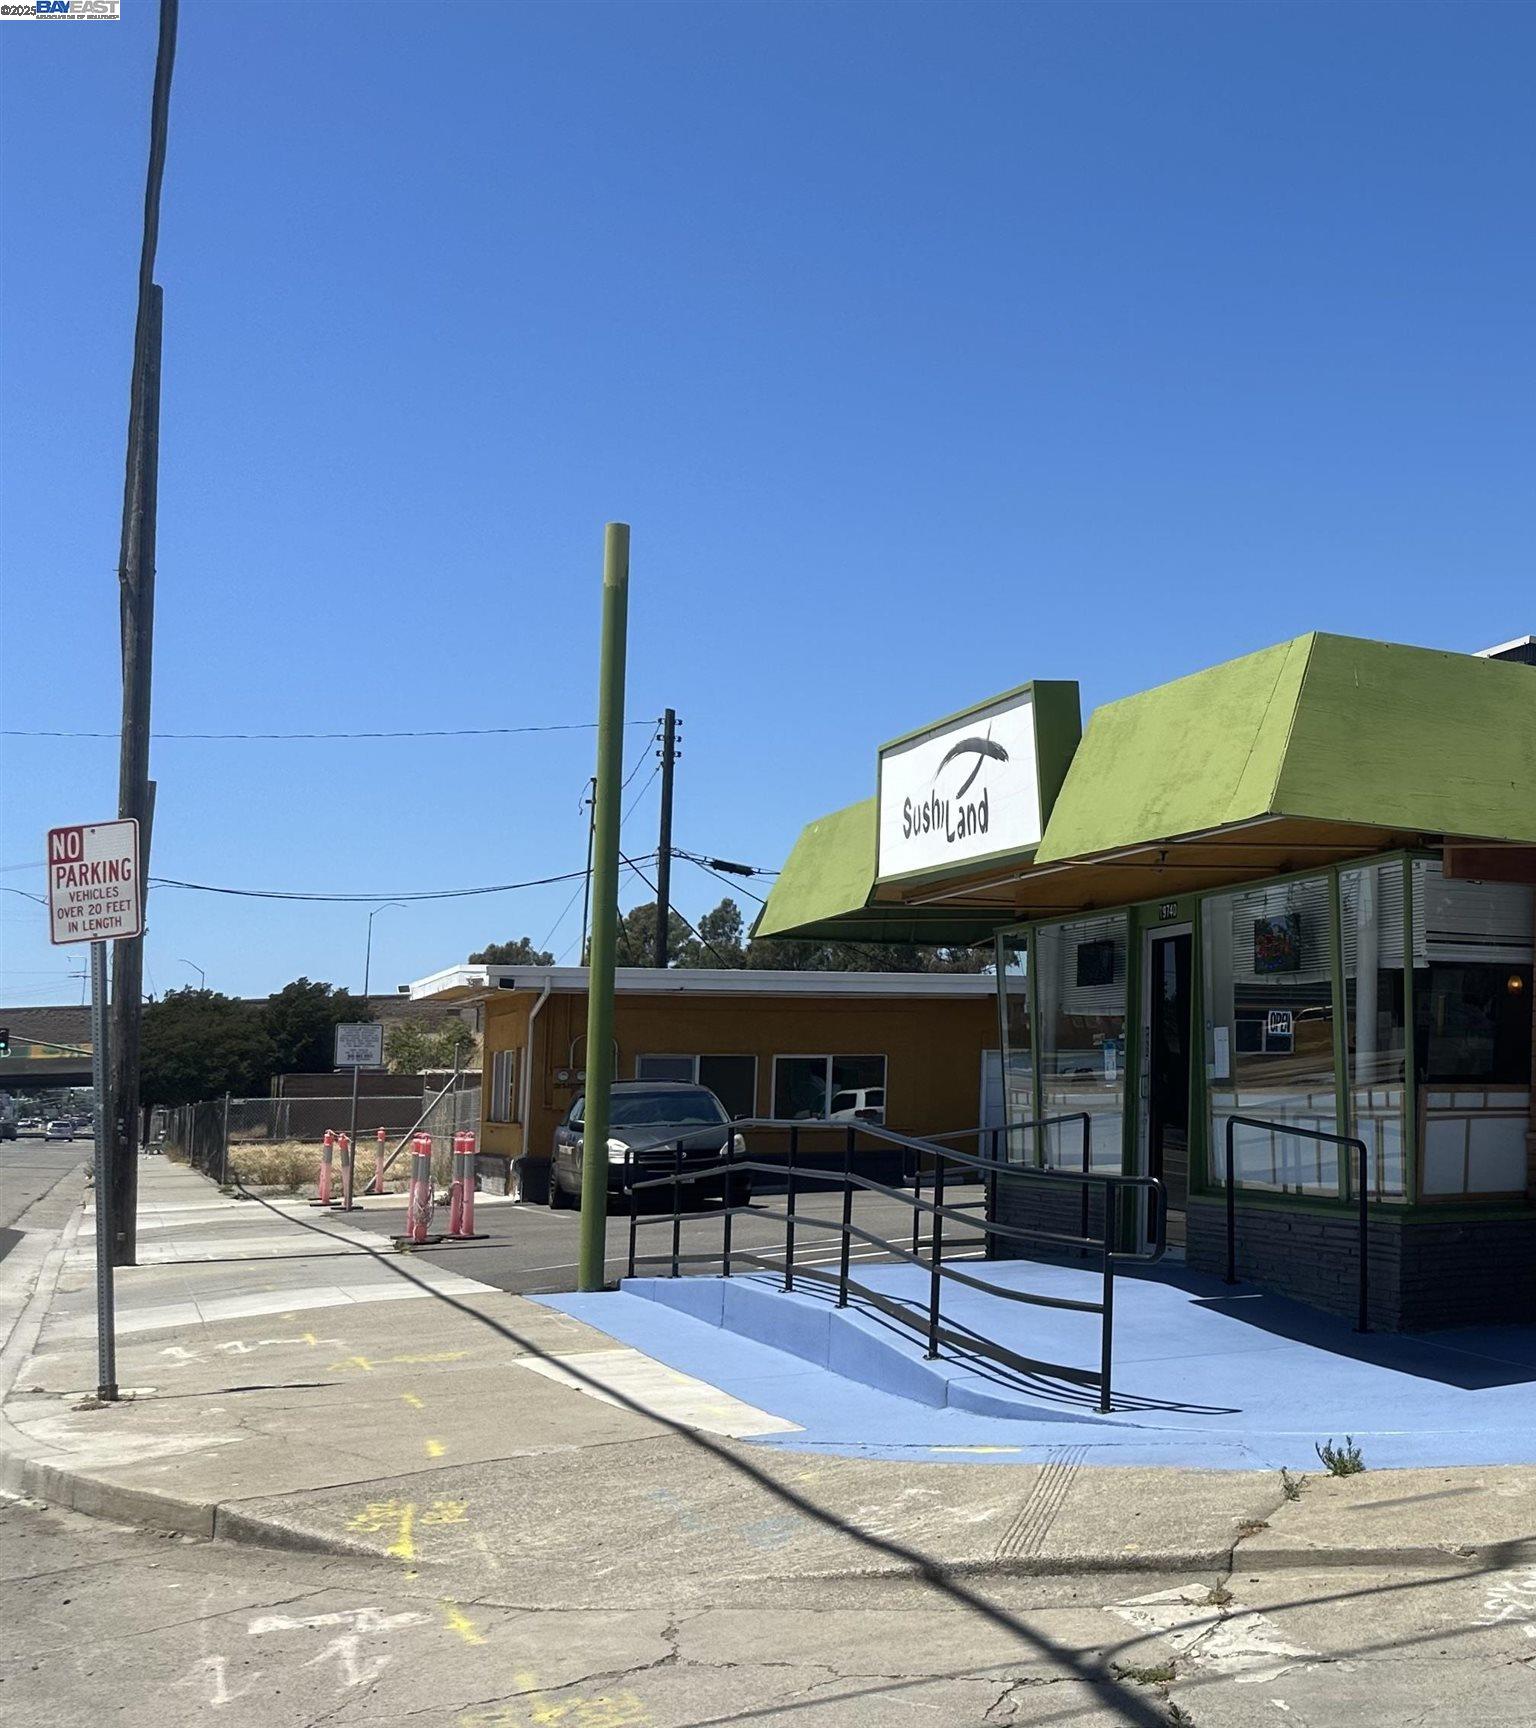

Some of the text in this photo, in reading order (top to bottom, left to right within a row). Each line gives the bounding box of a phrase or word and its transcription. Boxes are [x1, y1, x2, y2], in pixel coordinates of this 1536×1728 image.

[52, 831, 80, 860] NO
[56, 858, 131, 889] PARKING
[69, 886, 119, 902] VEHICLES
[57, 900, 131, 919] OVER 20 FEET
[68, 916, 122, 933] IN LENGTH
